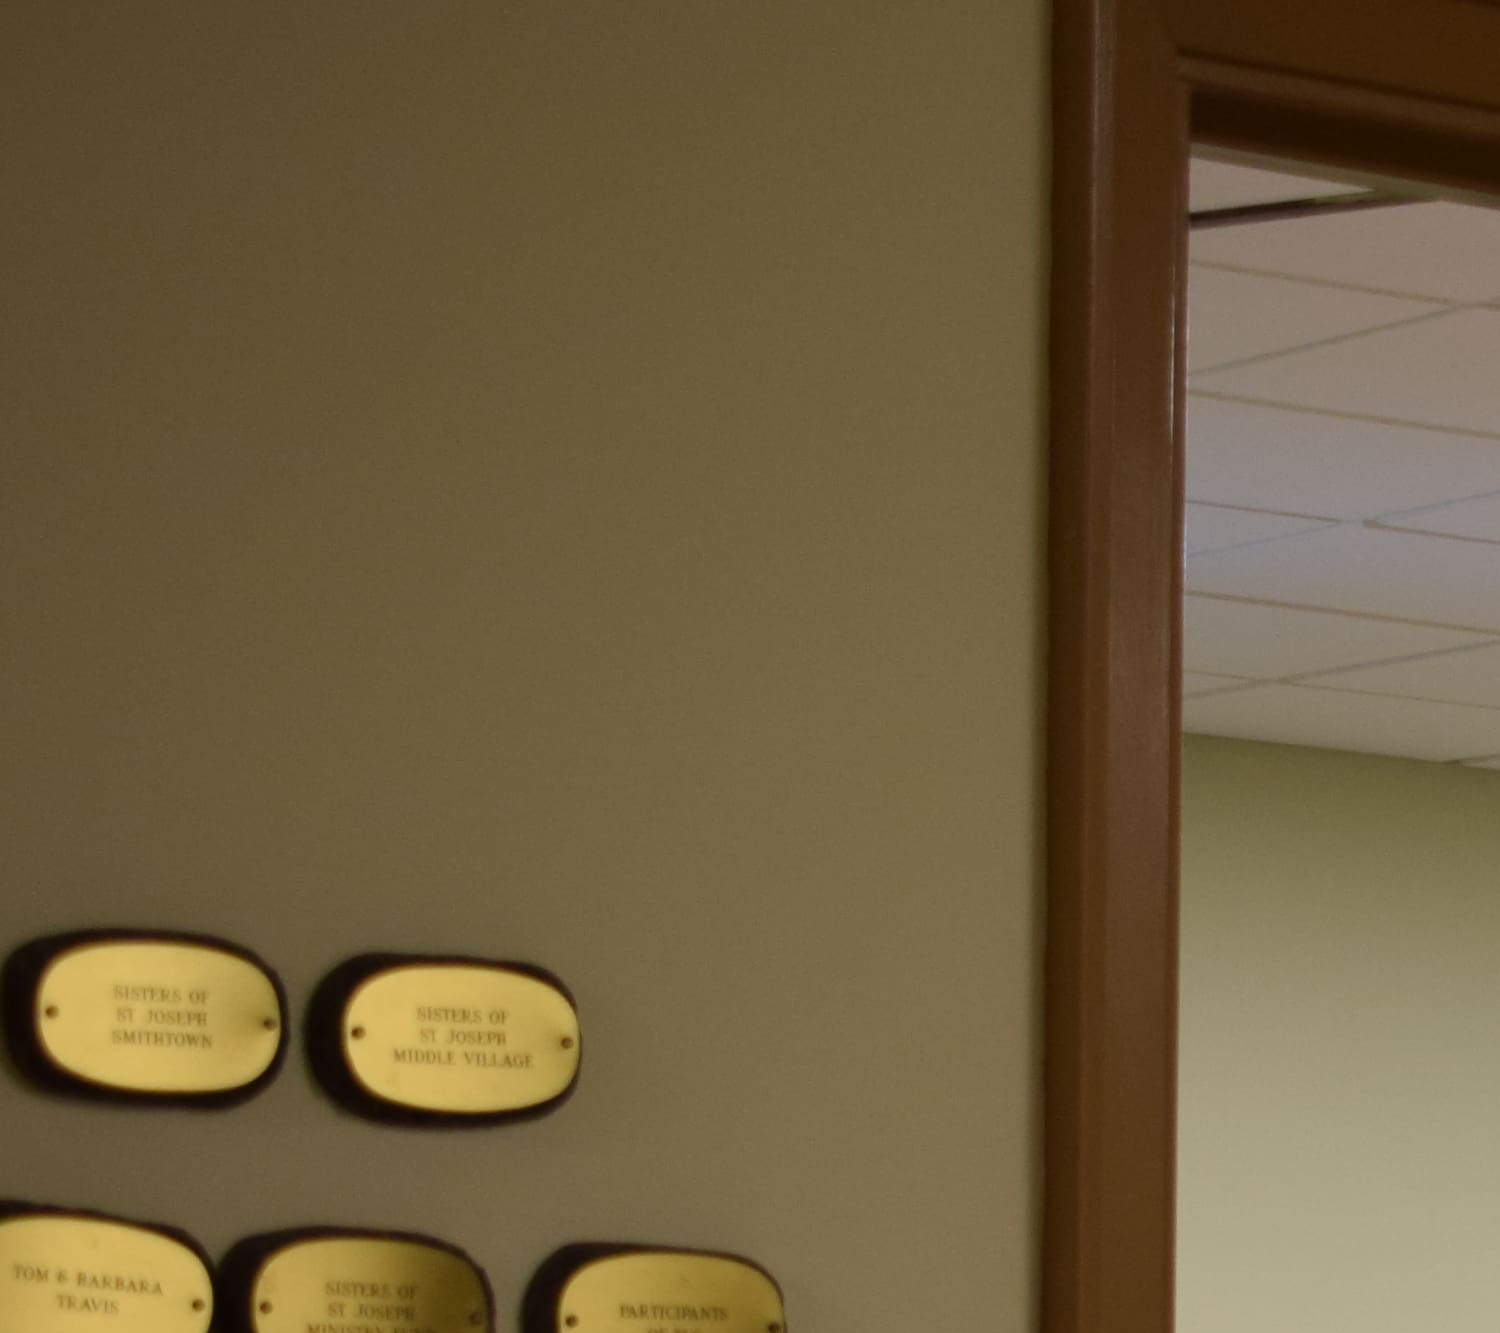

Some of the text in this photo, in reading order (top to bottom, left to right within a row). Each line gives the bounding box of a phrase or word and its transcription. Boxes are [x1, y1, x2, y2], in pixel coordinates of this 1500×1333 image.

[112, 984, 208, 1005] SISTERS OF
[116, 1007, 208, 1027] ST JOSEPH
[417, 1006, 508, 1025] SISTERS OF
[111, 1029, 213, 1048] SMITHTOWN
[419, 1028, 507, 1046] ST JOSEPH
[393, 1047, 533, 1069] MIDDLE VILLAGE
[13, 1263, 49, 1283] TOM
[77, 1271, 164, 1296] BARBARA
[325, 1280, 418, 1300] SISTERS OF
[56, 1293, 119, 1315] TRAVIS
[327, 1302, 416, 1322] ST JOSEPH
[618, 1304, 729, 1322] PARTICIPANTS
